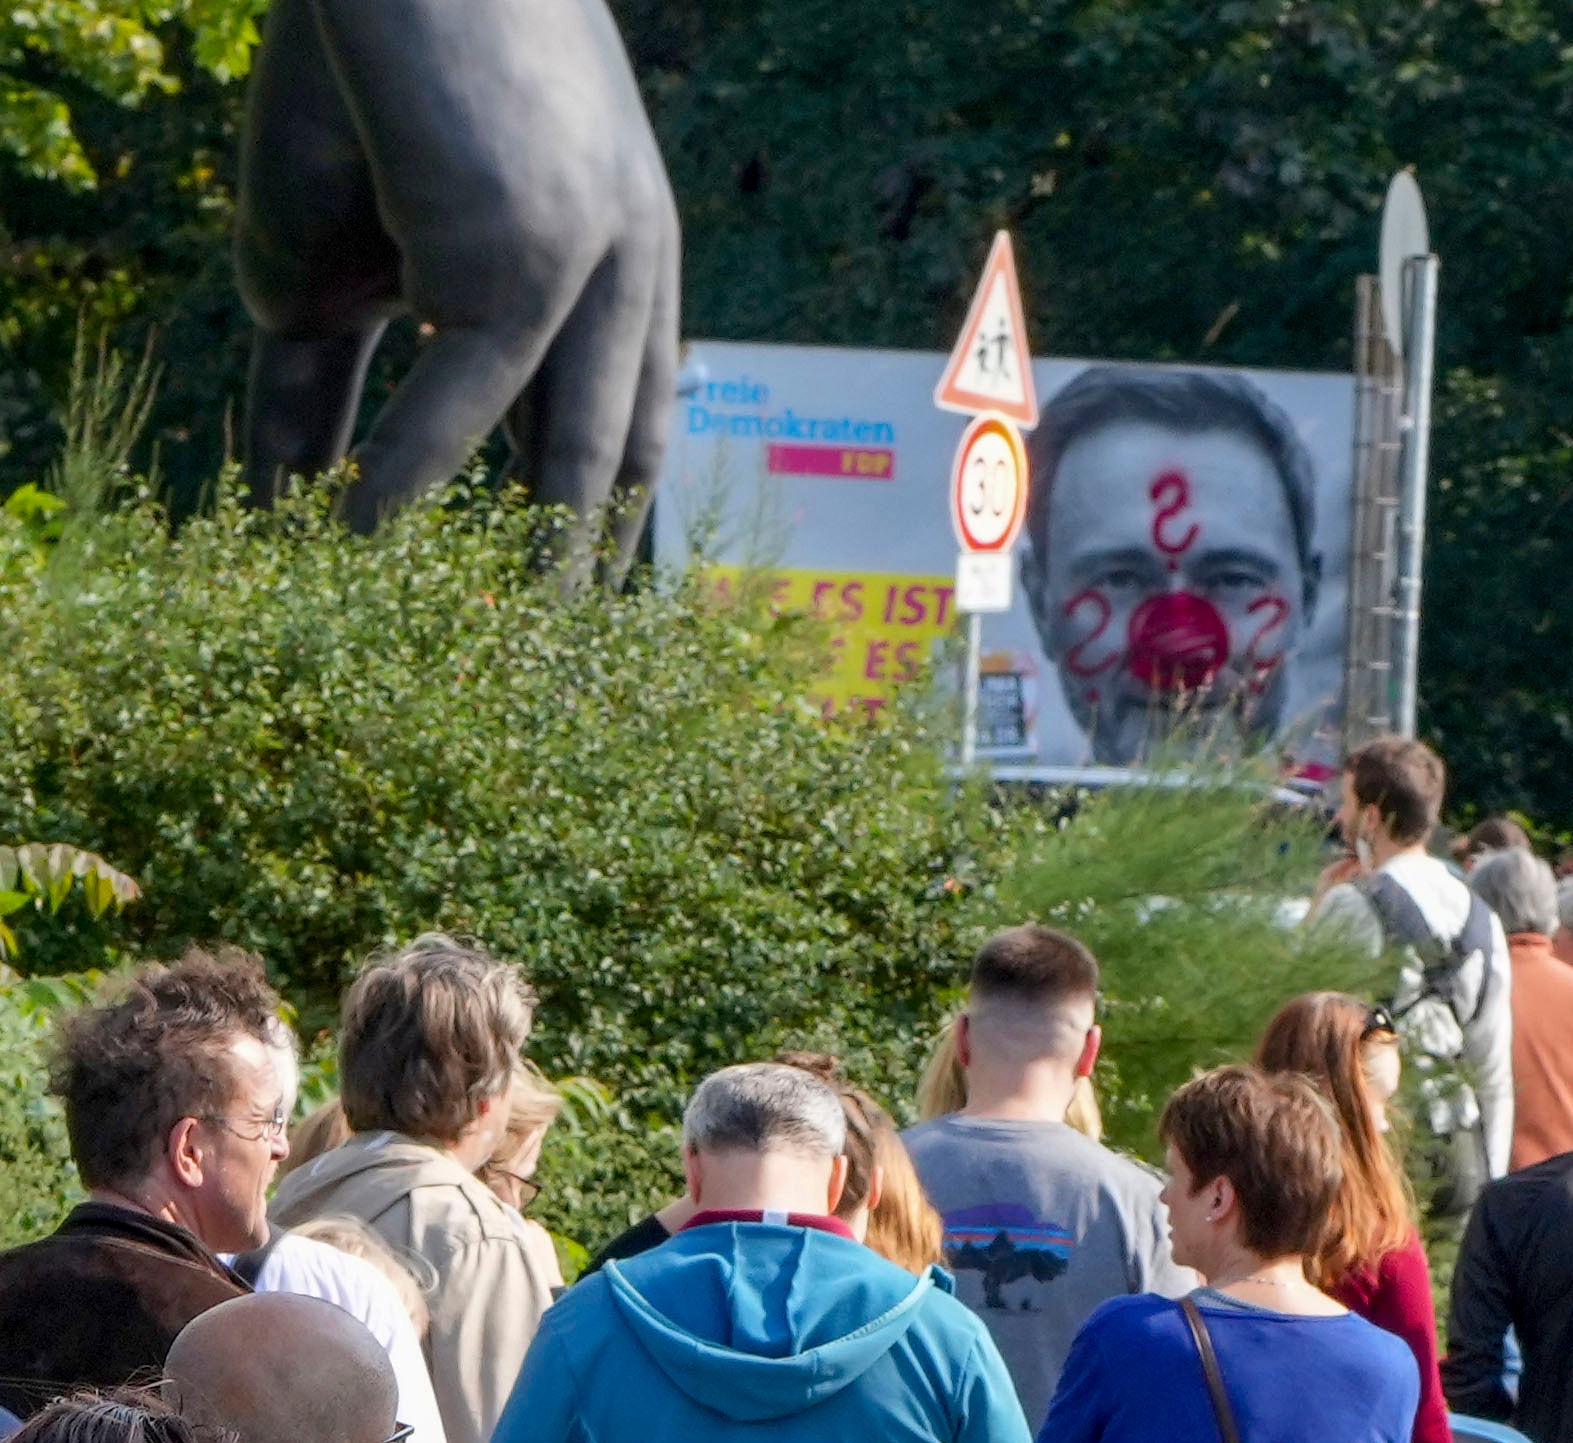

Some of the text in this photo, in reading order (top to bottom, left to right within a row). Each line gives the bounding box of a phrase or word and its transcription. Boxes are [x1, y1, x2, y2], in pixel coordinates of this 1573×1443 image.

[688, 406, 895, 443] Demokraten
[969, 455, 1007, 516] 30
[866, 639, 923, 681] ES
